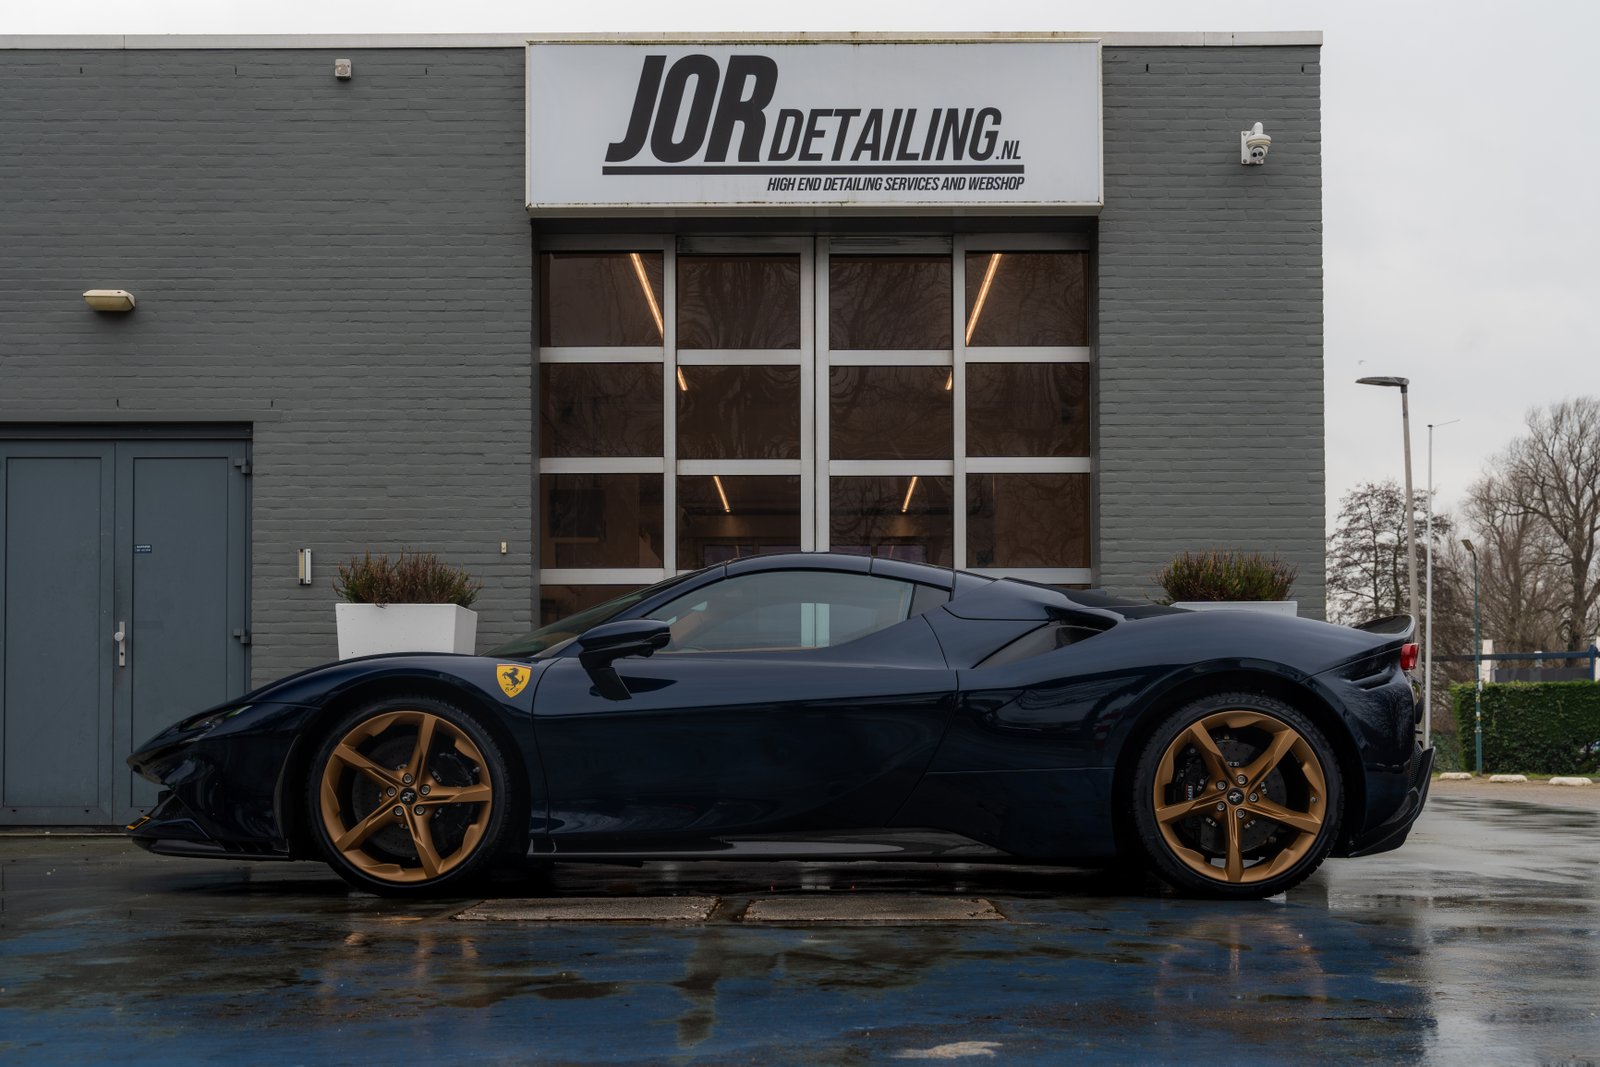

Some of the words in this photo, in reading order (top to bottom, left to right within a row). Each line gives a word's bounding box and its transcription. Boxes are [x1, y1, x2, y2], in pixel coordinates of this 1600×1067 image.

[604, 54, 779, 164] JOR
[766, 176, 797, 192] HIGH
[796, 176, 823, 192] END
[822, 176, 883, 192] DETAILING
[883, 176, 940, 192] SERVICES
[940, 176, 967, 192] AND
[968, 175, 1026, 192] WEBSHOP
